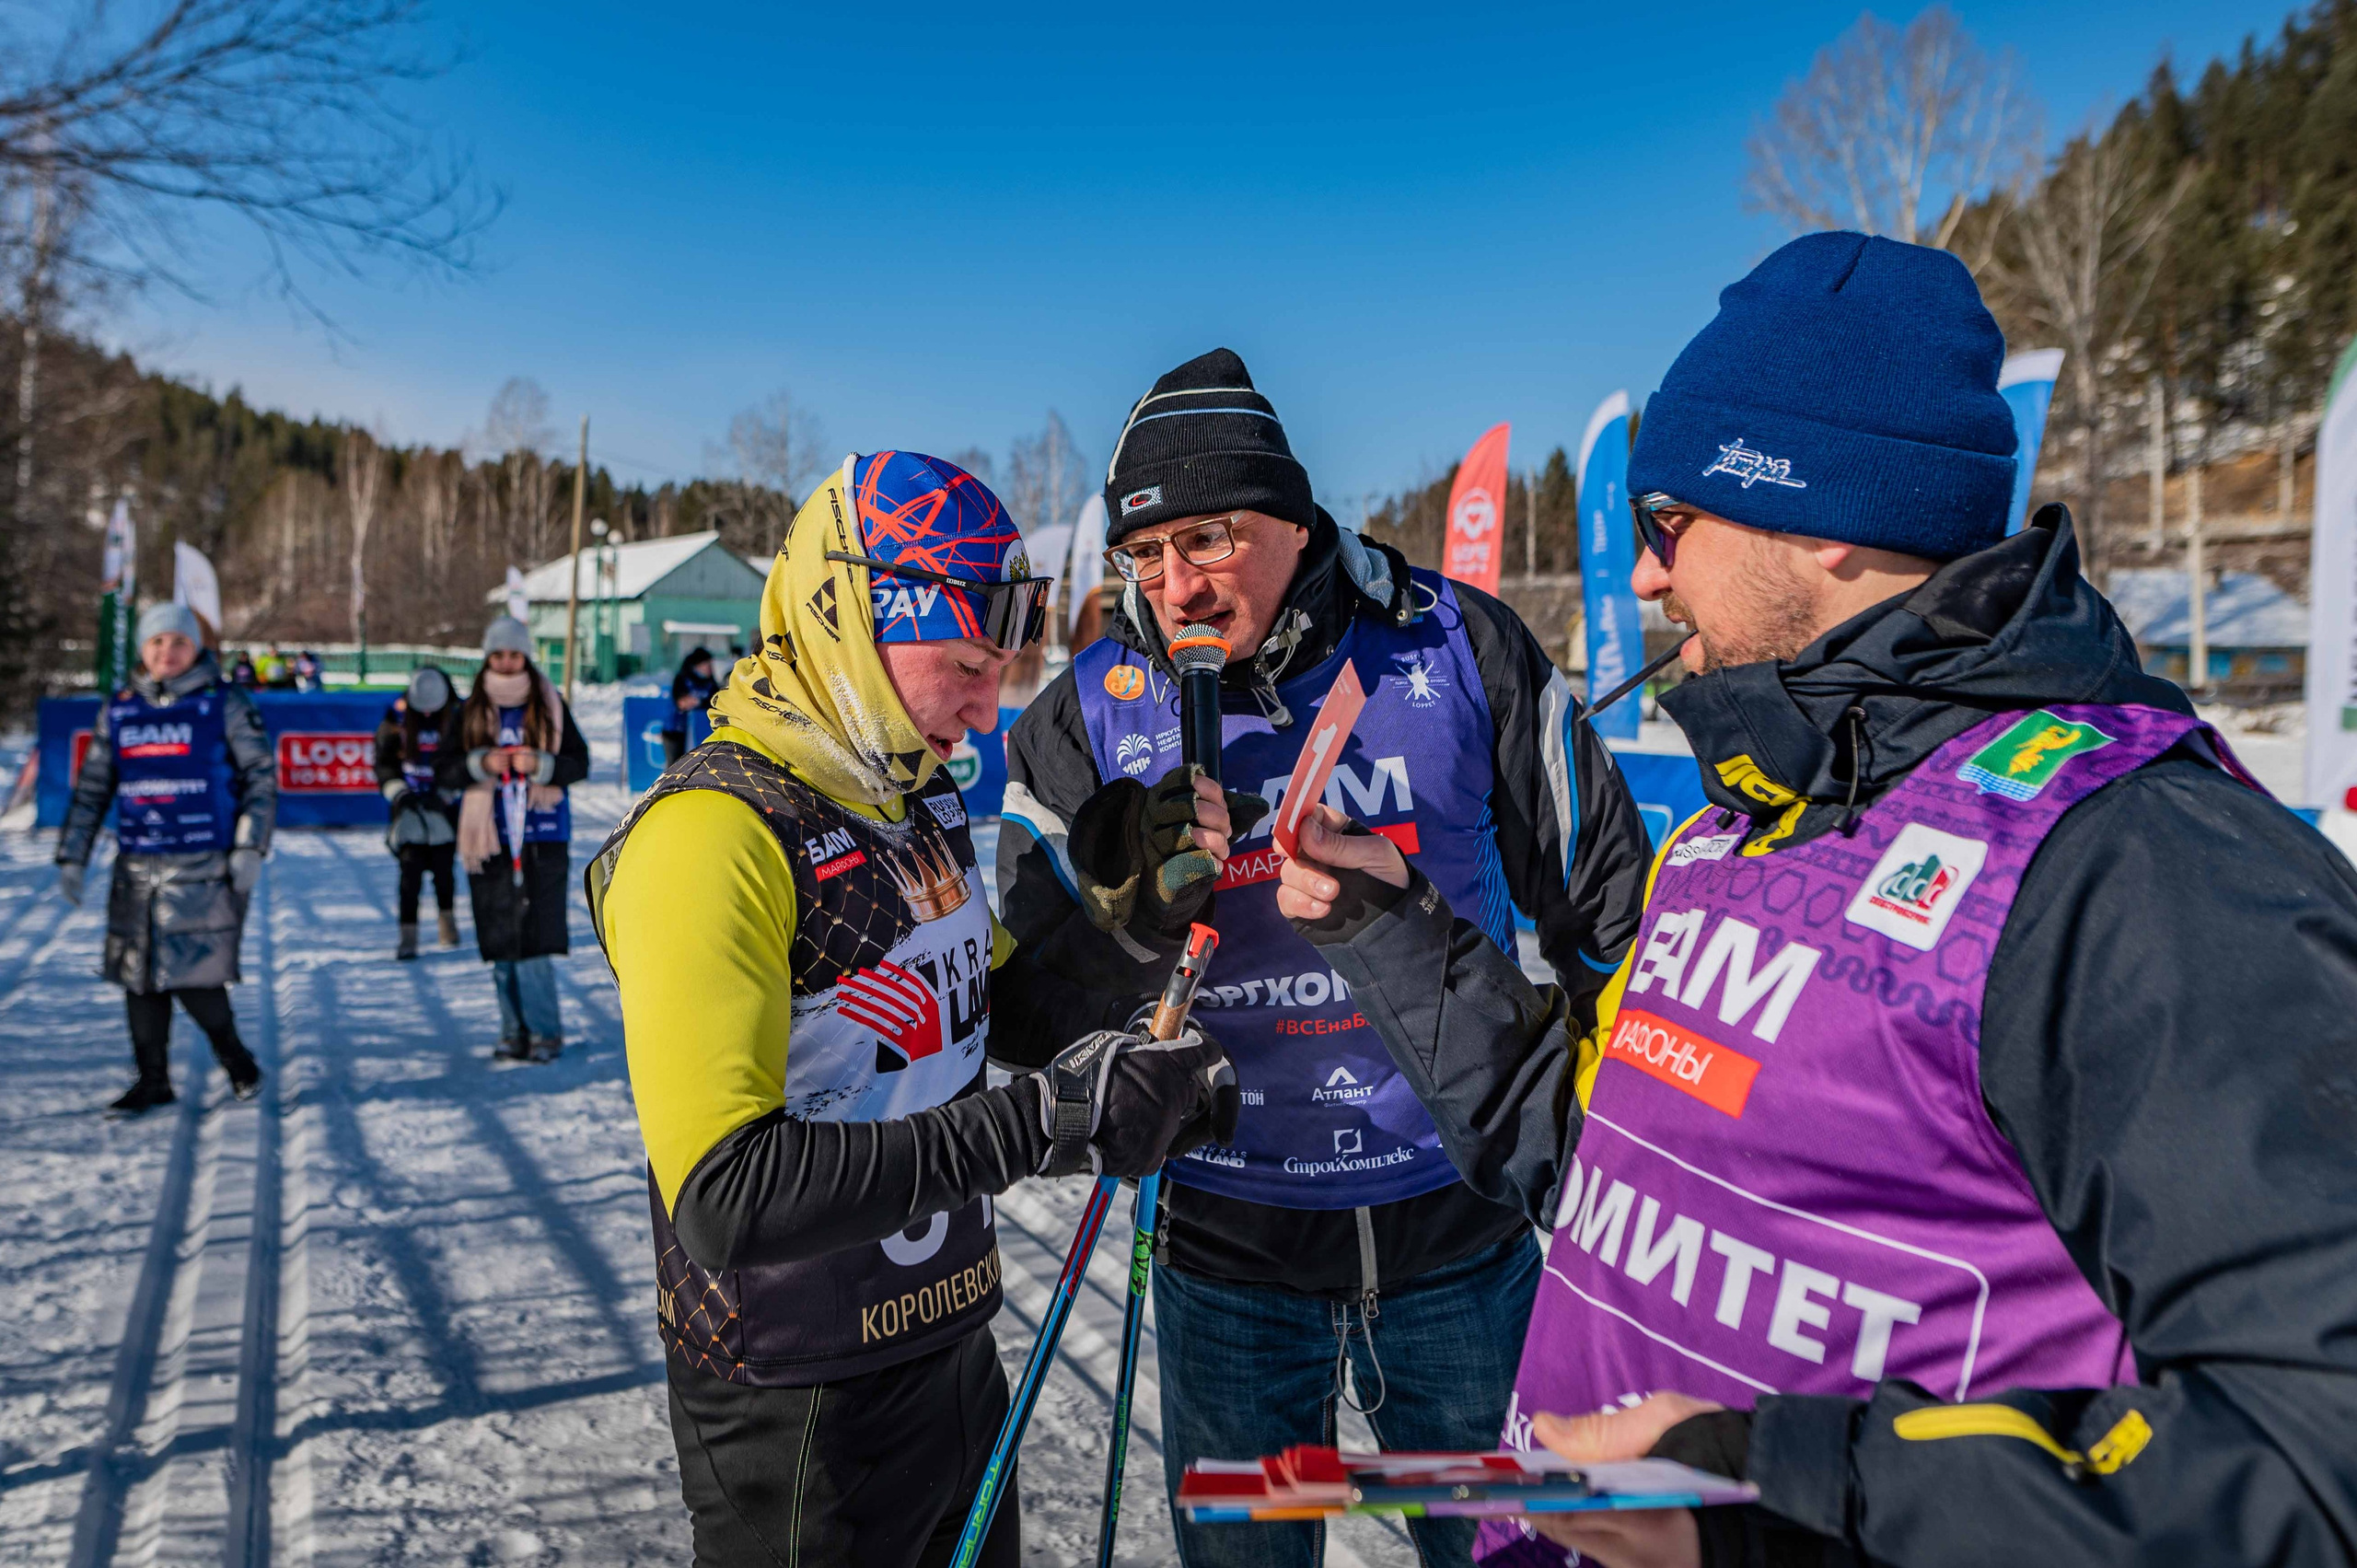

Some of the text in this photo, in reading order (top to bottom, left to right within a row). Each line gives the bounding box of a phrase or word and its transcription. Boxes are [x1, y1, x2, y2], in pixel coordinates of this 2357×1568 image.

[805, 601, 841, 643] FISCHER
[806, 827, 857, 865] БАМ
[1275, 1013, 1370, 1036] #ВСЕнаБ
[1311, 1086, 1374, 1102] Атлант
